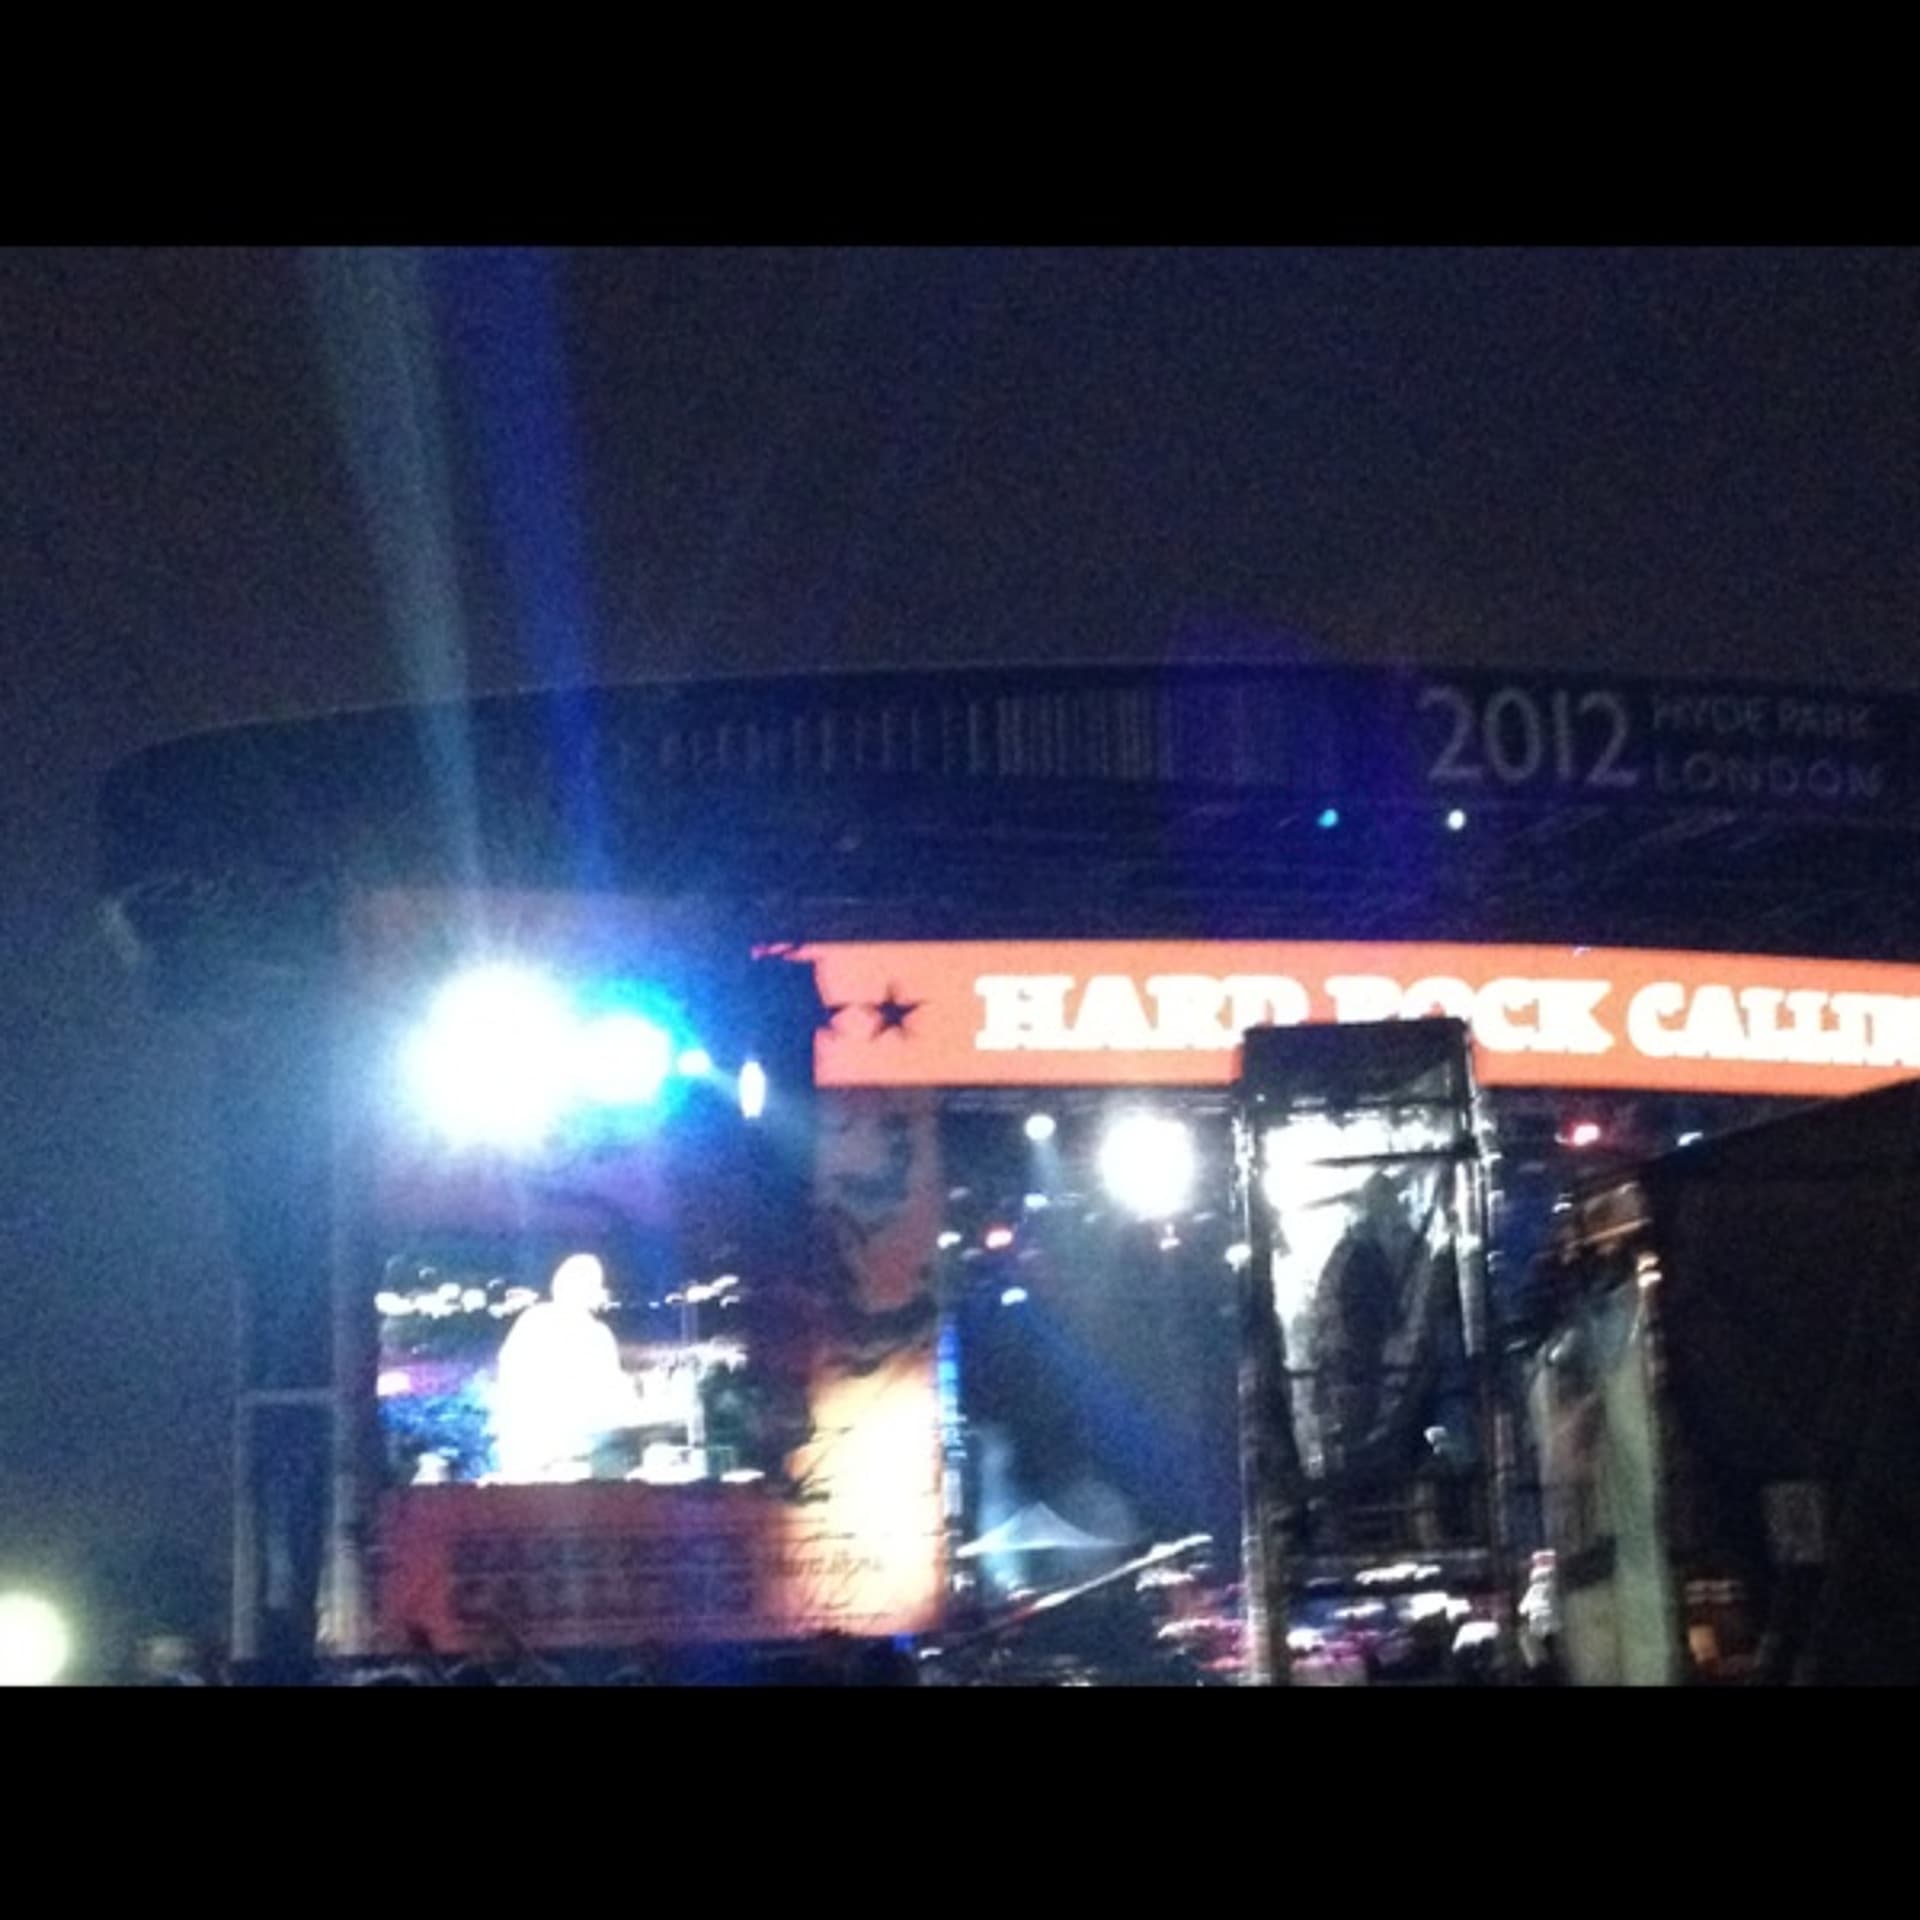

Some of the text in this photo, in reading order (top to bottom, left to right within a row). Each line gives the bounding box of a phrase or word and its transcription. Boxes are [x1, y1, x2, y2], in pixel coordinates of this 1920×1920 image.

[1418, 686, 1638, 787] 2012
[1651, 695, 1874, 739] HYDE PARK
[1655, 750, 1885, 798] LONDON
[974, 973, 1310, 1050] HARD
